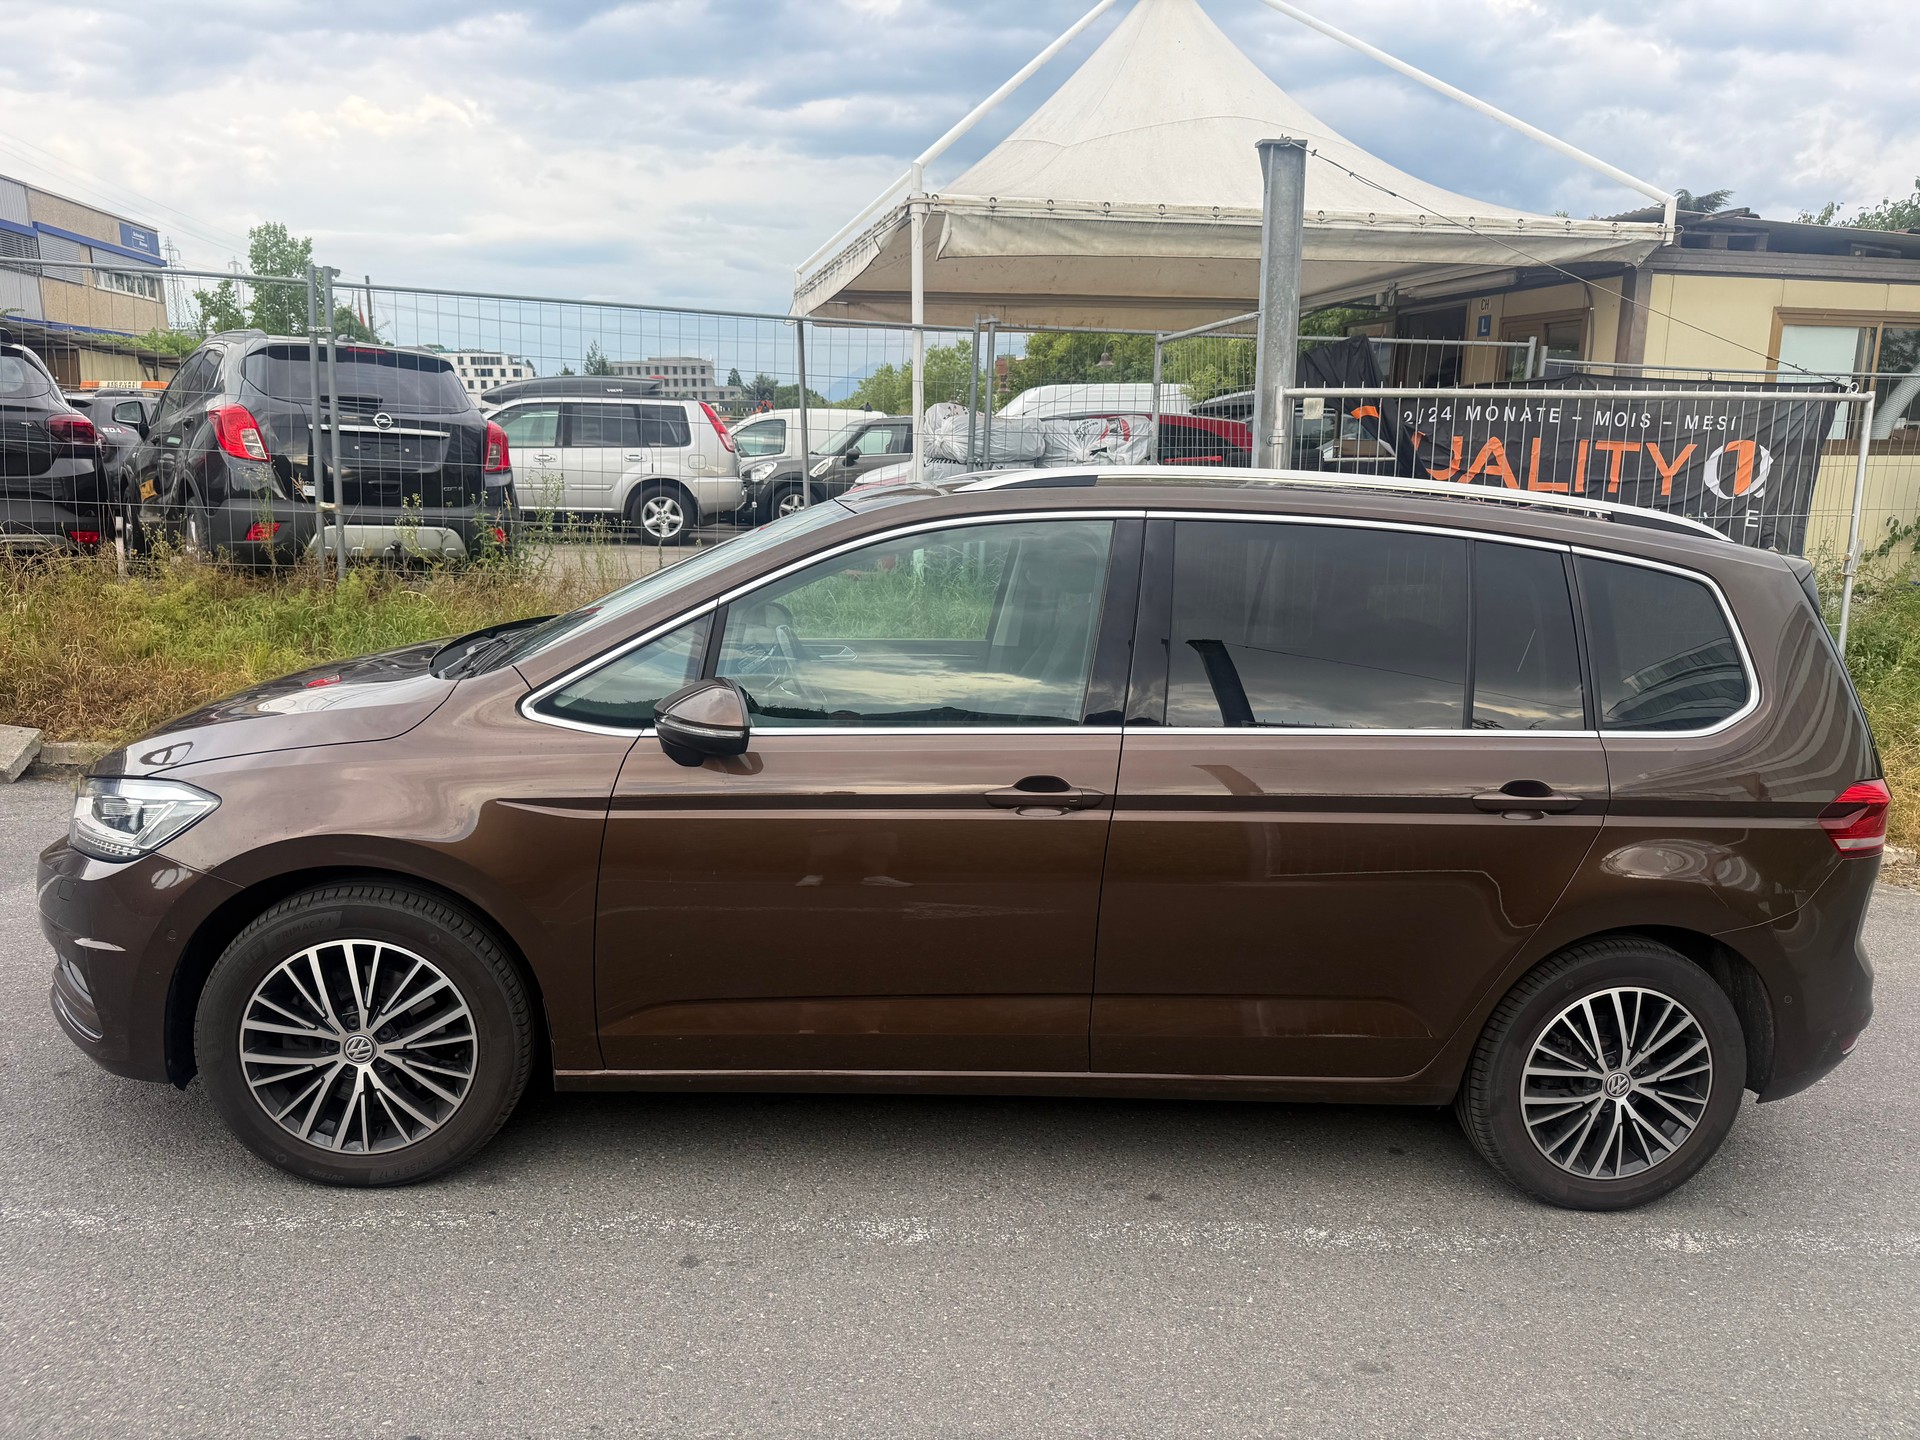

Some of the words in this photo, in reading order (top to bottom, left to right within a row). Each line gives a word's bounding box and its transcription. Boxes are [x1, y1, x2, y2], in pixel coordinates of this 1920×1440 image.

[1465, 405, 1561, 423] MONATE
[1595, 411, 1652, 428] MOIS
[1684, 415, 1737, 431] MESI
[1411, 430, 1698, 496] UALITY
